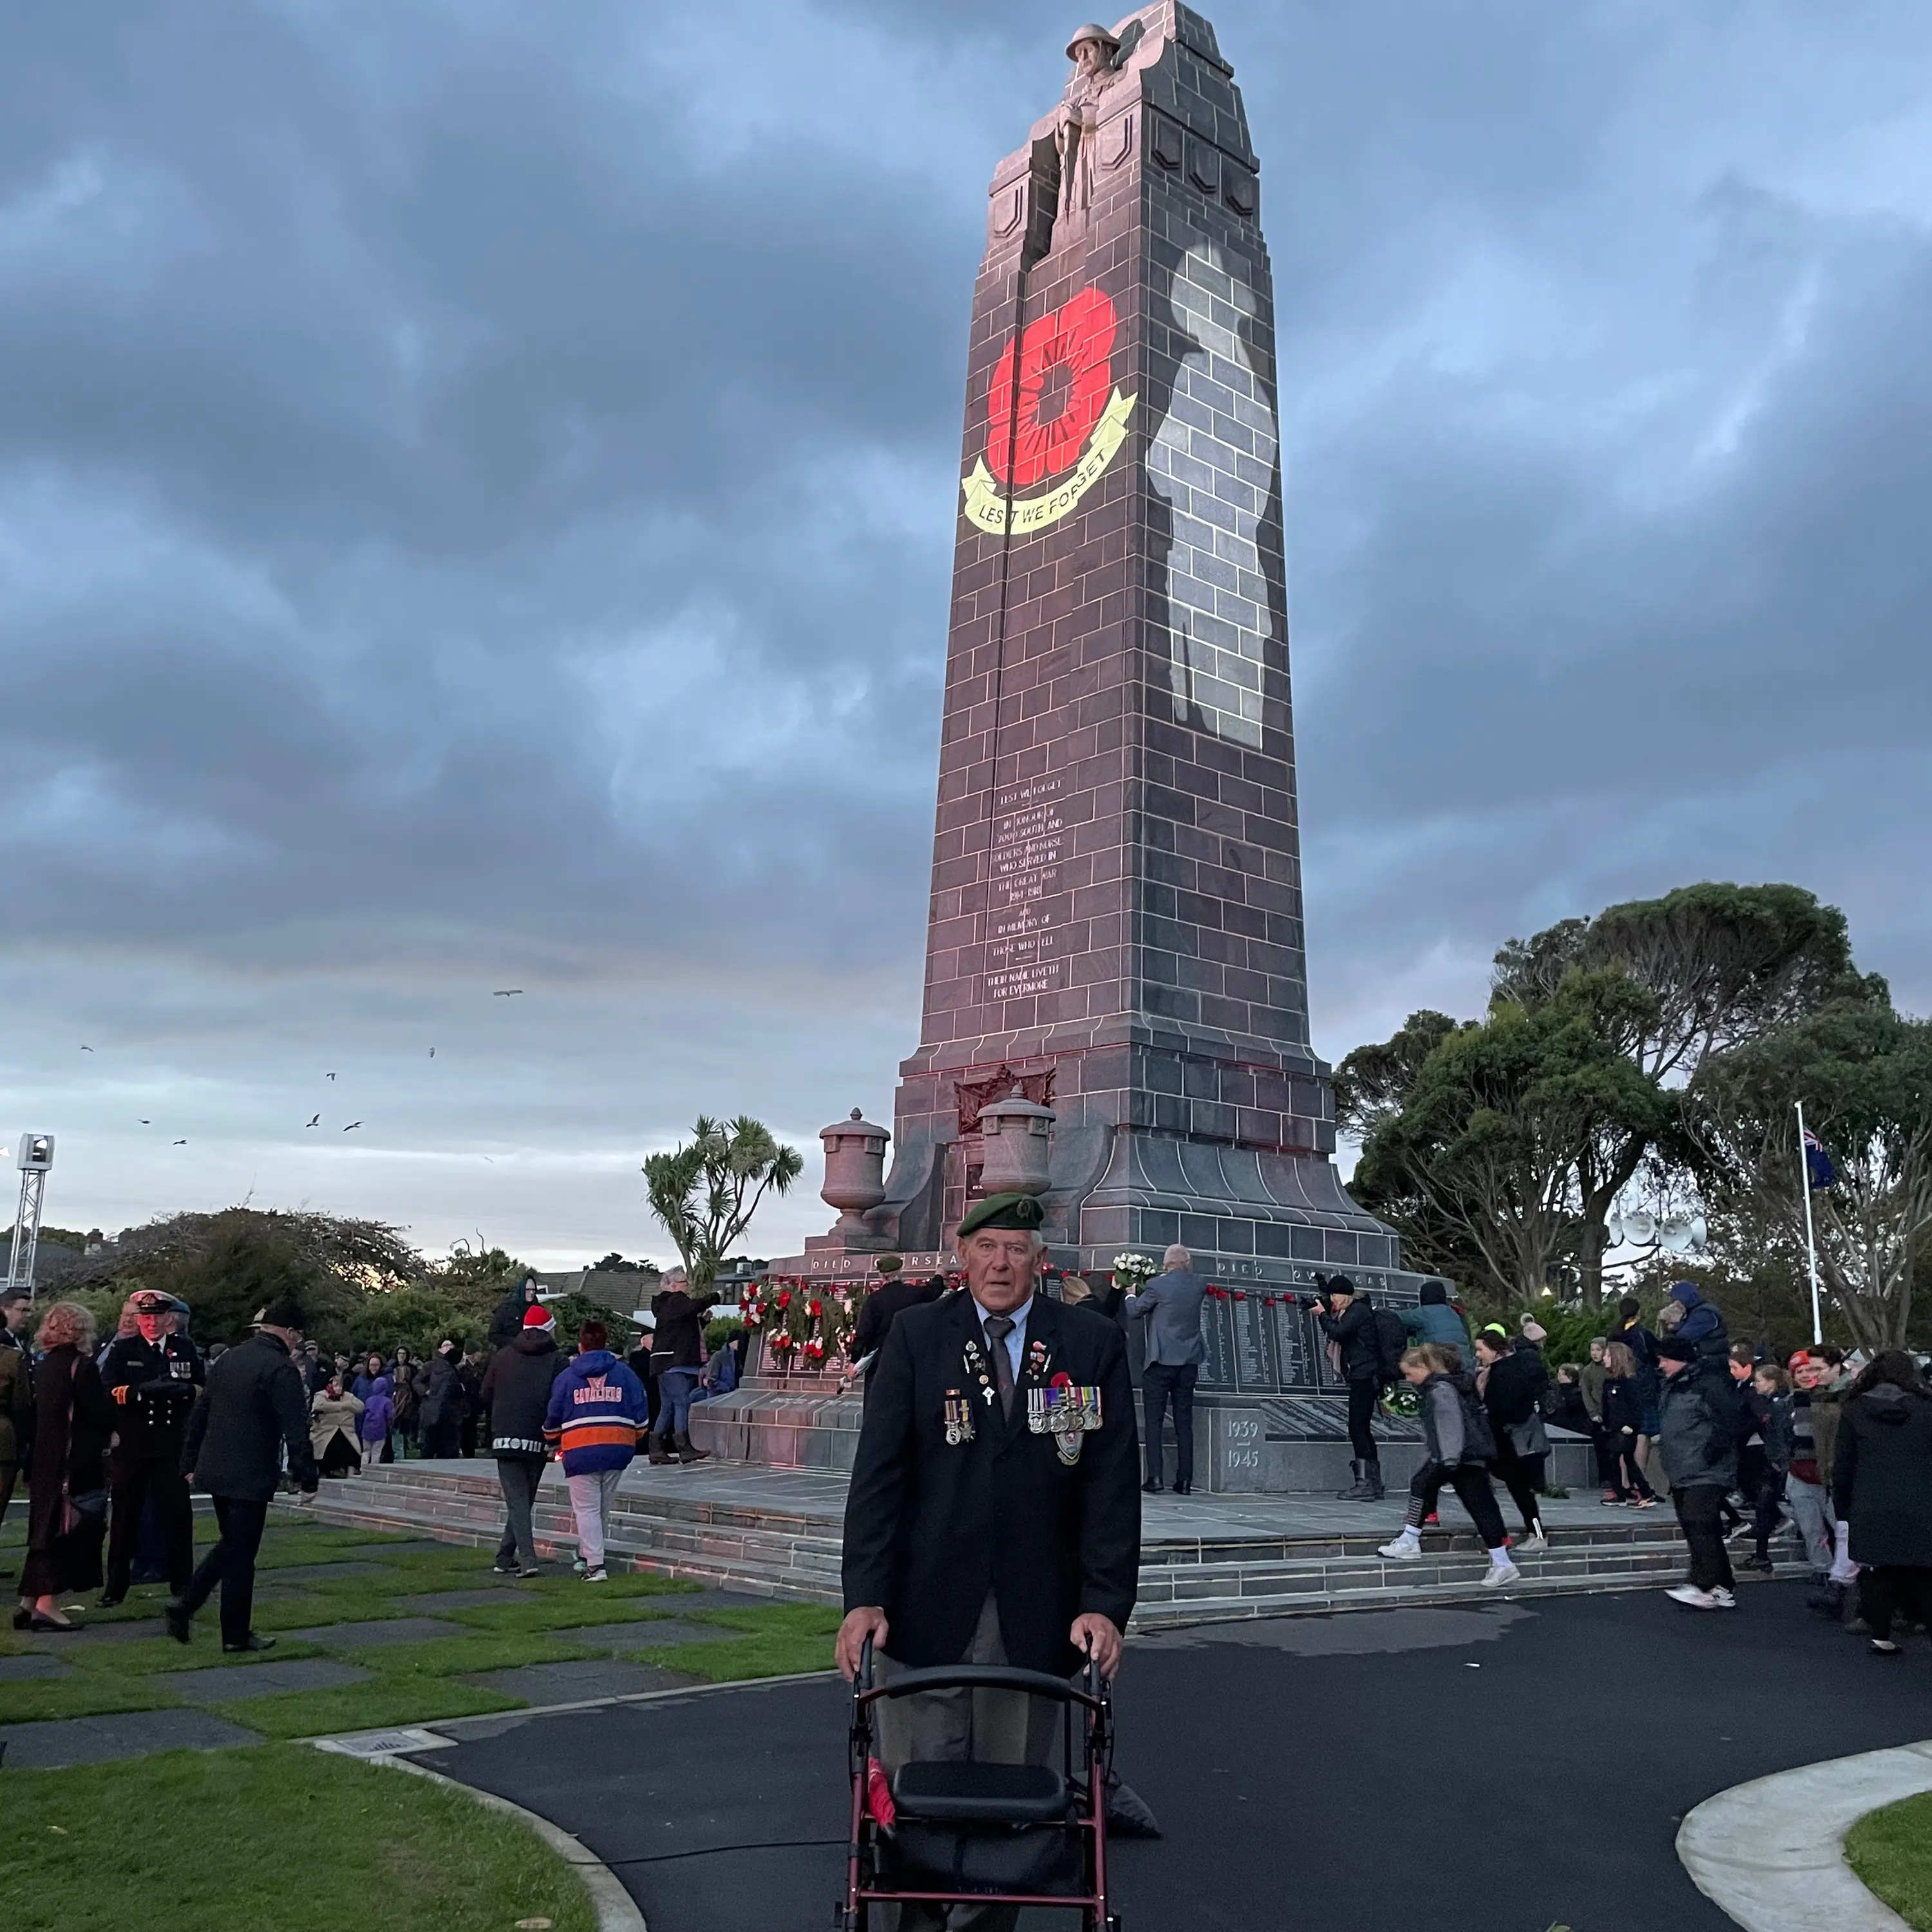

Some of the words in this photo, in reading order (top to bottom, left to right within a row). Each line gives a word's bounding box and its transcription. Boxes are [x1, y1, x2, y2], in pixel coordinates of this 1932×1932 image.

[979, 504, 1018, 524] LEST
[1023, 505, 1044, 524] WE
[1049, 448, 1106, 515] FORGET
[1032, 964, 1059, 978] LIVETH
[1218, 1262, 1263, 1276] DIED
[1228, 1419, 1258, 1438] 1939
[1227, 1448, 1258, 1468] 1945
